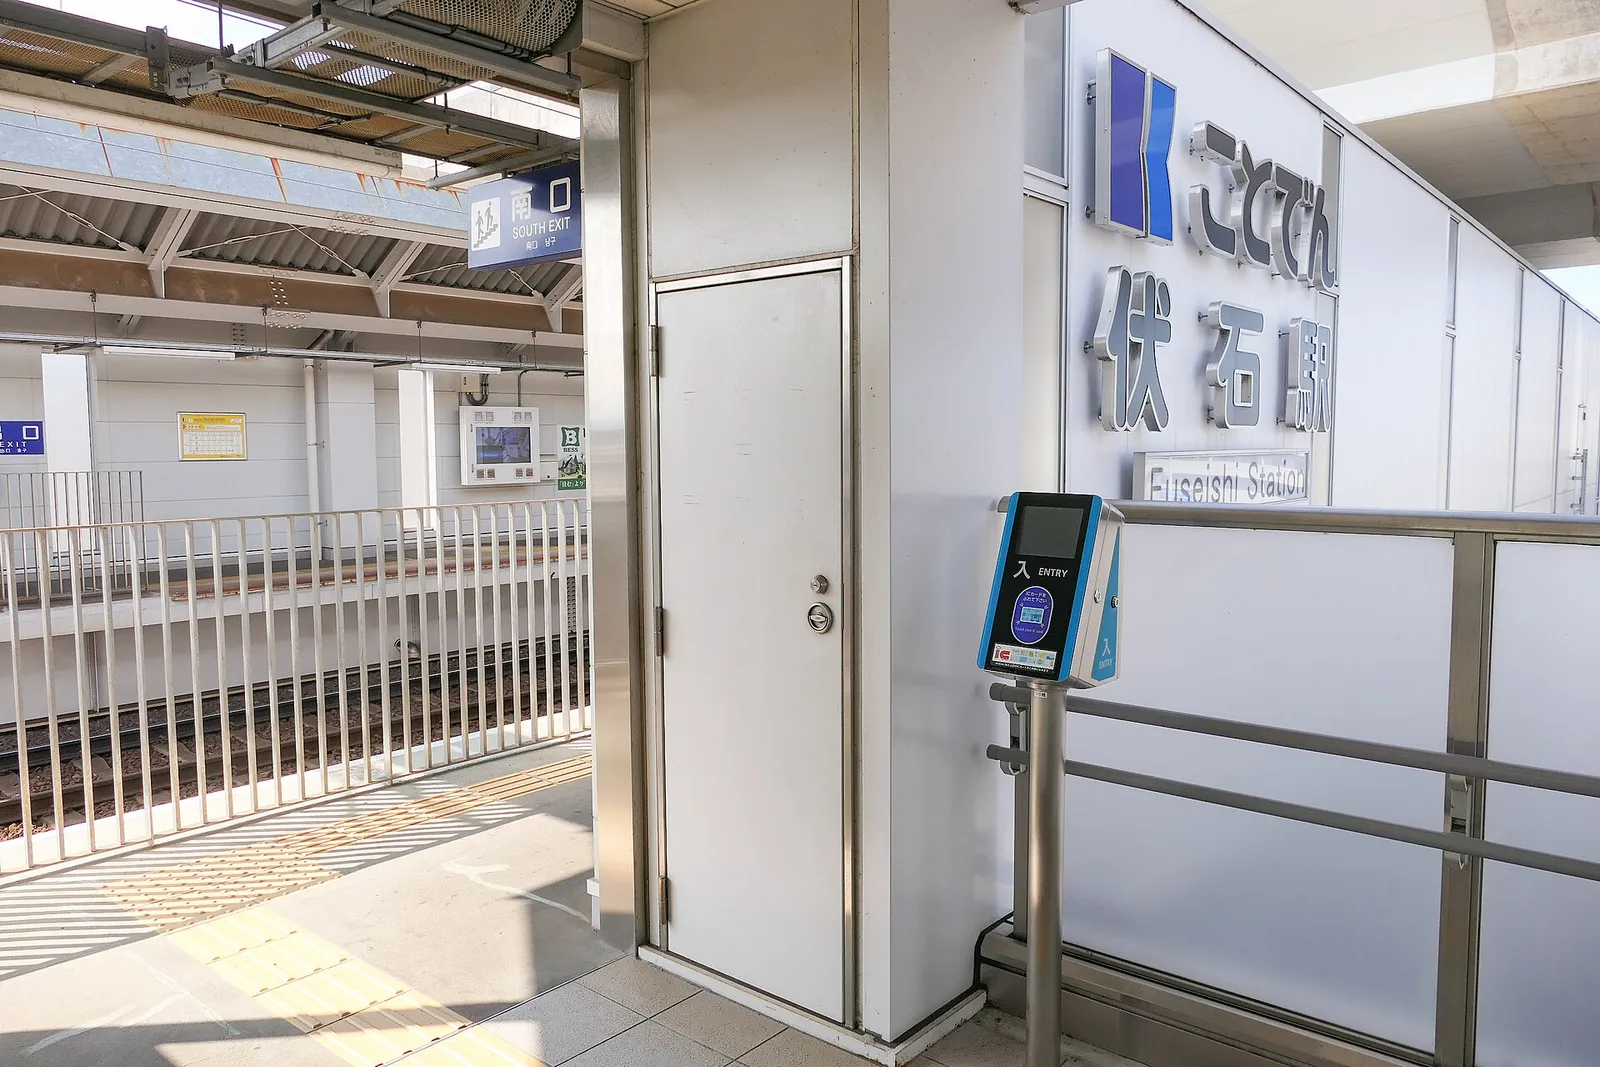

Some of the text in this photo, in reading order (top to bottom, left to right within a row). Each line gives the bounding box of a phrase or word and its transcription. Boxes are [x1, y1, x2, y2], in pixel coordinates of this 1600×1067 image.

[511, 178, 571, 222] 南口
[1190, 120, 1336, 292] ことでん
[513, 217, 571, 239] SOUTH EXIT
[1094, 265, 1333, 433] 伏石駅
[1150, 460, 1305, 503] Fuseishi Station
[1012, 560, 1031, 580] 入
[1038, 567, 1069, 578] ENTRY
[1102, 638, 1111, 657] 入
